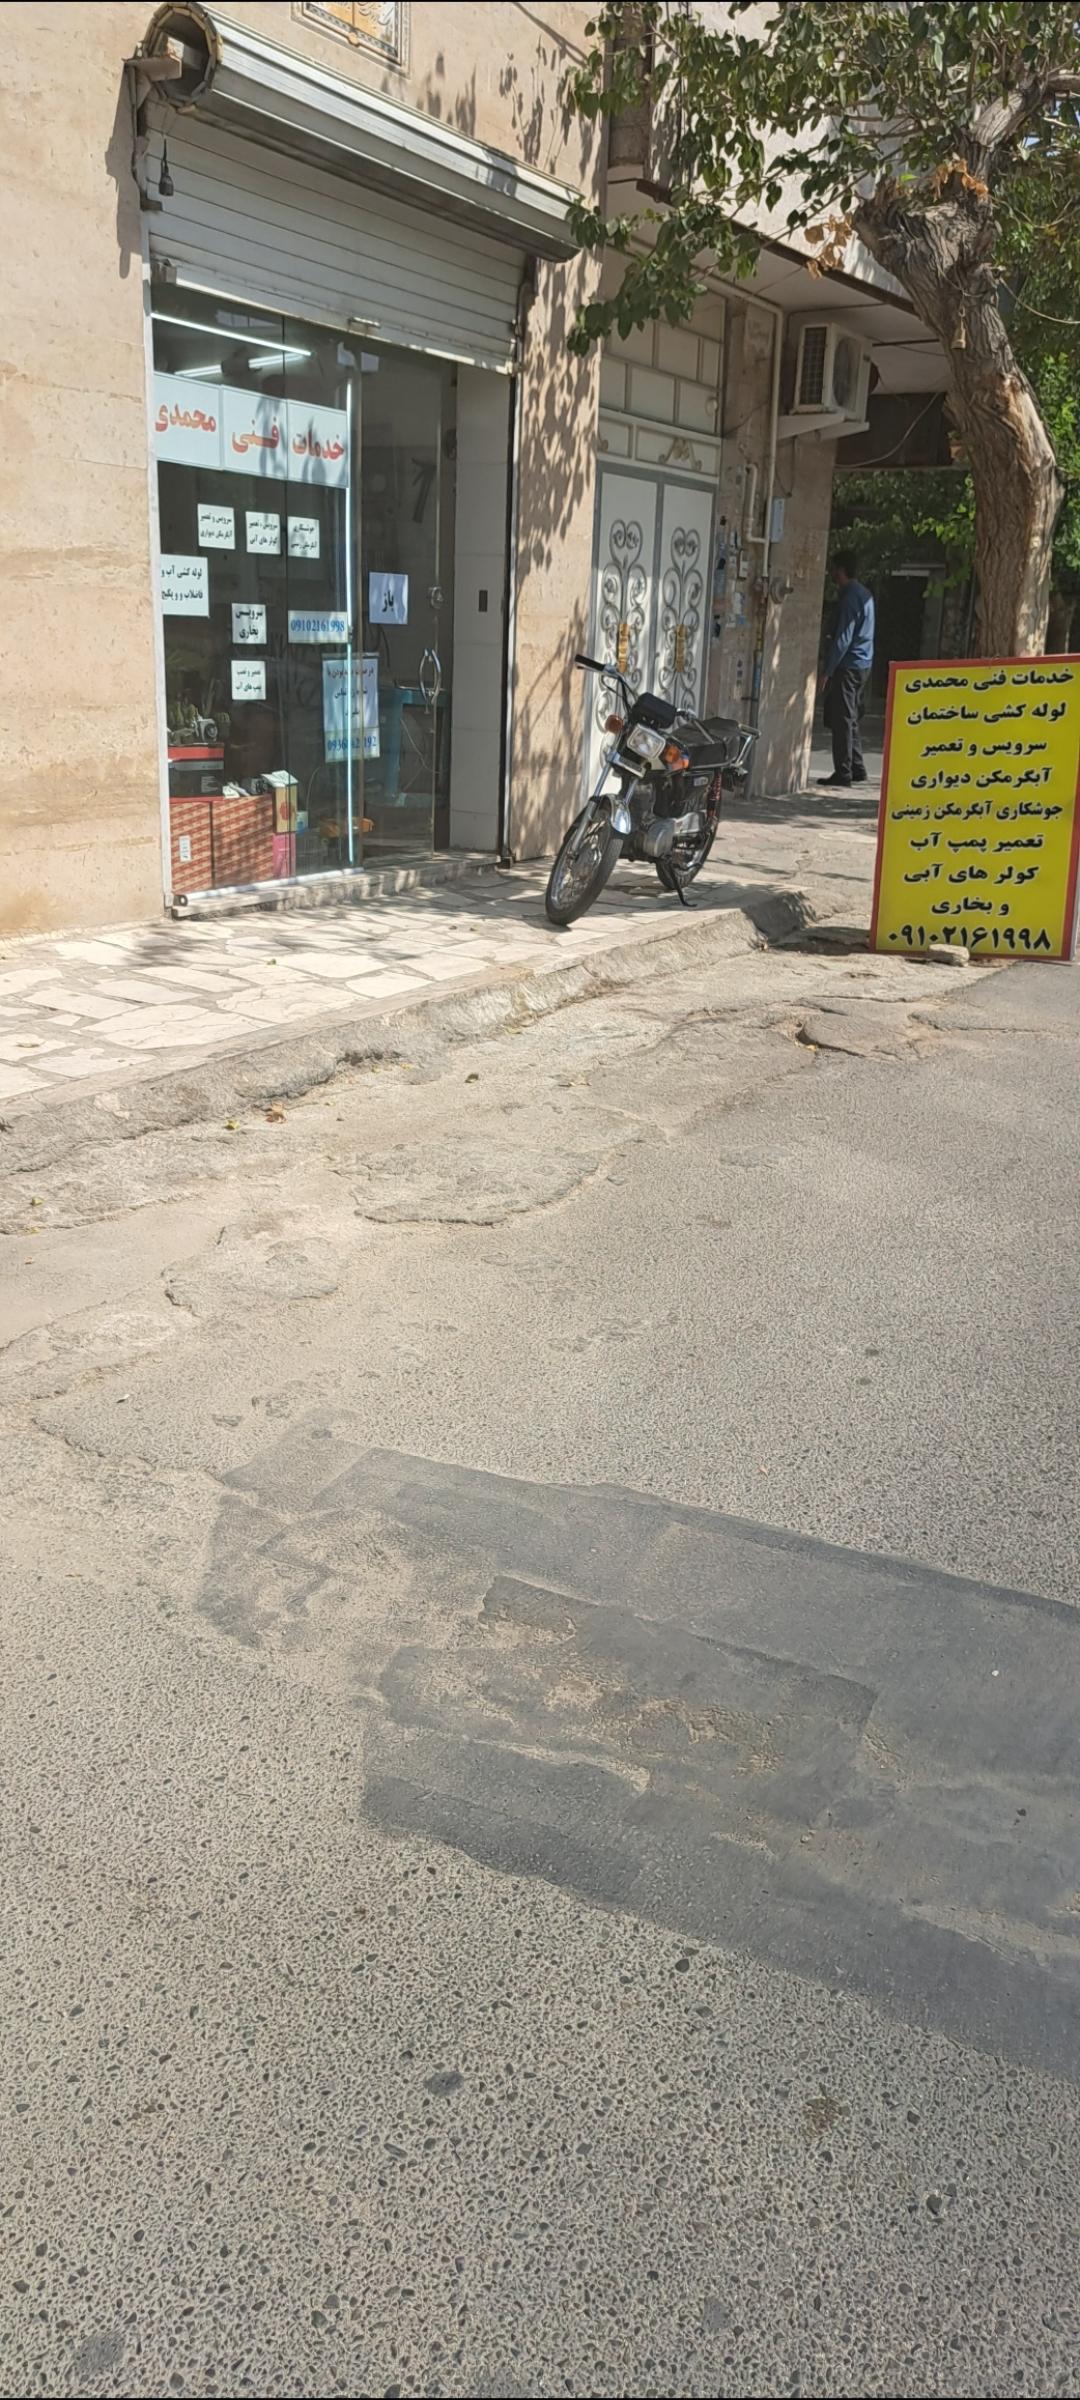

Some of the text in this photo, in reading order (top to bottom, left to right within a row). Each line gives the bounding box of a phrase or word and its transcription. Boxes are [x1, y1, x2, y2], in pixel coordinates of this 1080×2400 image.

[155, 403, 345, 461] خدمات فنی محمدی
[161, 565, 202, 580] لوله کشی آب و
[382, 590, 394, 612] باز
[235, 610, 263, 620] سرویس
[239, 624, 258, 638] بخاری
[291, 619, 345, 633] 09102161998
[904, 669, 1074, 692] خدمات فنی محمدی
[907, 702, 1066, 725] لوله کشی ساختمان
[920, 738, 1047, 757] سرویس و تعمیر
[911, 767, 1051, 788] آبگرمکن دیواری
[891, 800, 1063, 820] جوشکاری آبگرمکن زمینی
[910, 832, 1044, 852] تعمیر پمپ آب
[904, 863, 1039, 884] کولر های آبی
[931, 897, 1009, 915] و بخاری
[888, 924, 1051, 950] ۰۹۱۰۲۱۶۱۹۹۸
